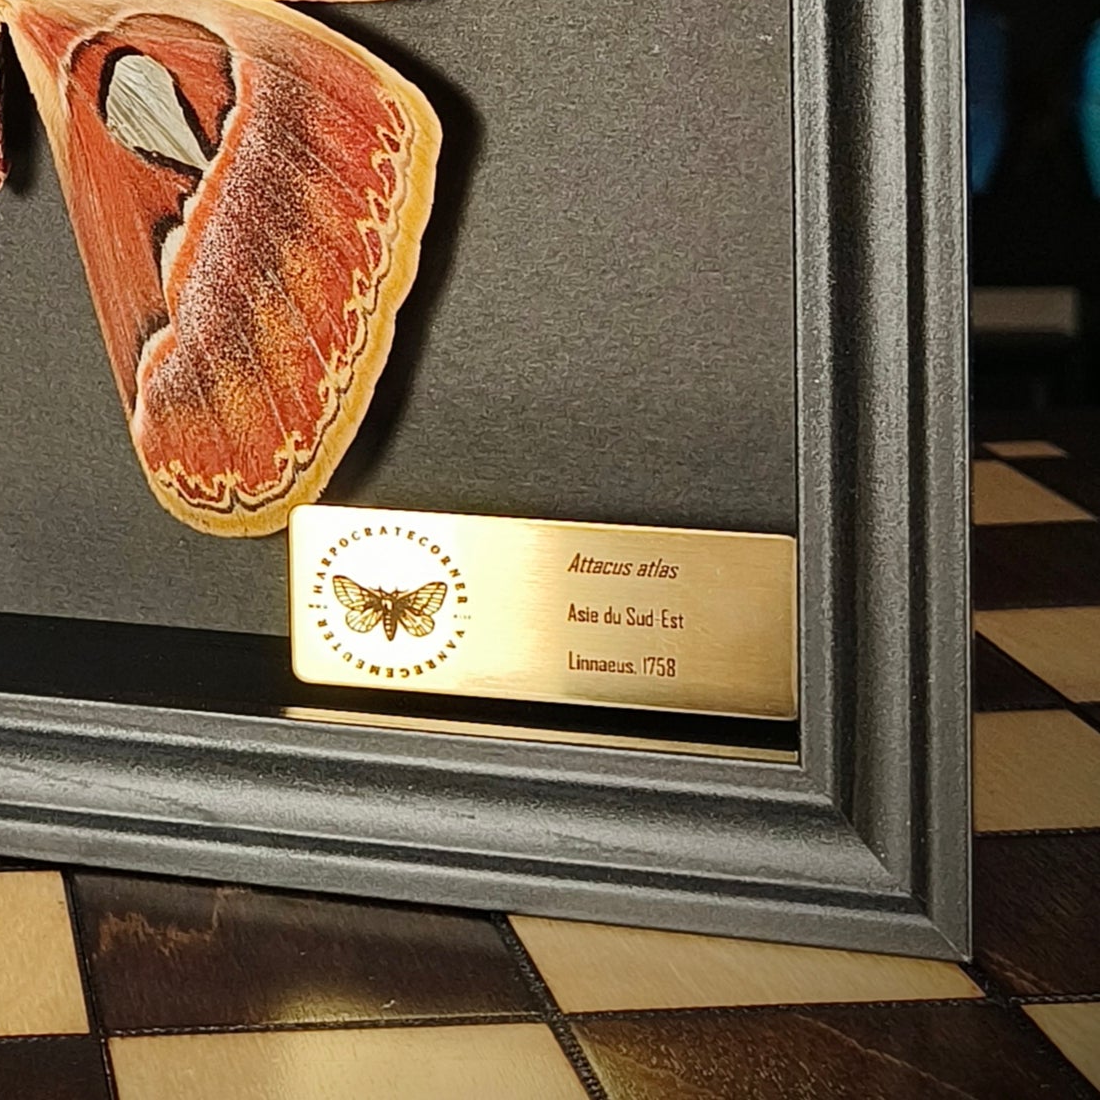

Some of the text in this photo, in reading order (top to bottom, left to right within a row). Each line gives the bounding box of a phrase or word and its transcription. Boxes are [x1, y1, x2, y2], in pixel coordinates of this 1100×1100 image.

[567, 553, 679, 579] Attacus atlas
[568, 603, 599, 623] Asie
[604, 606, 621, 625] du
[643, 657, 676, 678] 1758
